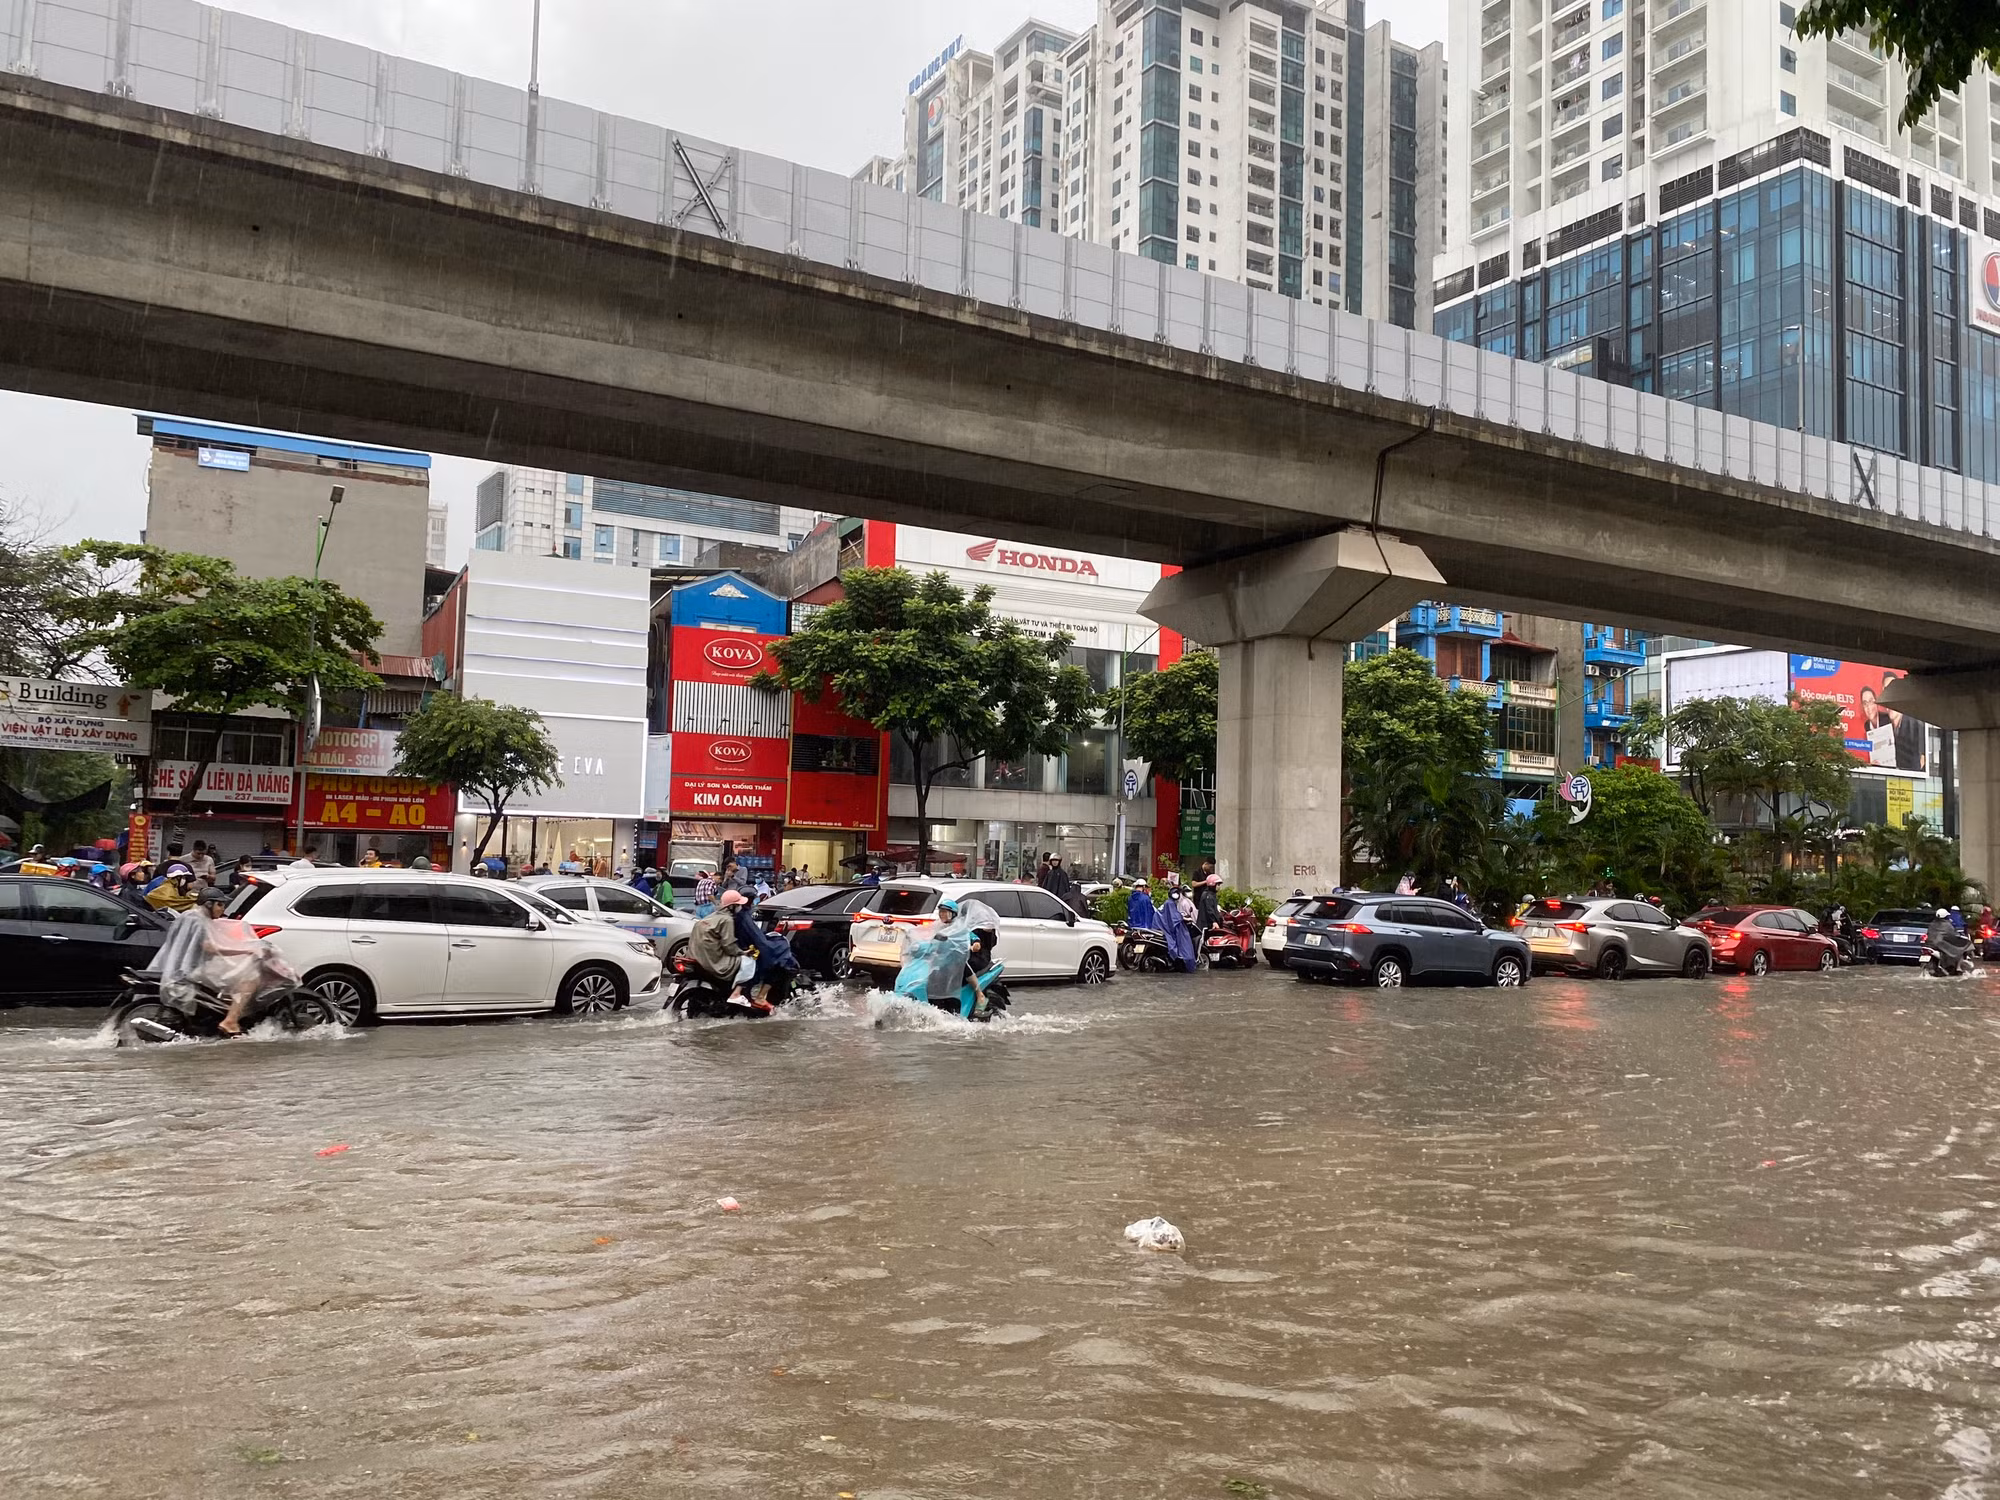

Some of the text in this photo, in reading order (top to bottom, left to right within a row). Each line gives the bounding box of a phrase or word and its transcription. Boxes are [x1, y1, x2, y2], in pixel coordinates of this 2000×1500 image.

[997, 549, 1099, 577] HONDA
[1020, 629, 1046, 639] ATEXIM
[1041, 620, 1048, 628] VÀ
[1090, 626, 1098, 634] BỘ
[712, 646, 755, 661] KOVA
[1836, 693, 1855, 704] IELTS
[38, 716, 105, 728] BỘ XÂY DỰNG
[2, 722, 138, 742] VIỆN VẬT LIỆU XÂY DỰNG
[316, 731, 386, 749] HOTOCOPY
[714, 746, 746, 757] KOVA
[355, 753, 385, 767] SCAN
[574, 756, 604, 776] EVA
[179, 763, 203, 789] SẦ
[206, 767, 234, 791] LIÊN
[237, 769, 253, 792] ĐÀ
[307, 773, 439, 796] PHOTOCOPY
[684, 780, 773, 791] ĐẠI LÝ SƠN VÀ CHỐNG THẤM
[234, 792, 252, 801] 237
[693, 793, 763, 808] KIM OANH
[320, 801, 358, 824] A4
[1293, 864, 1317, 876] ER18
